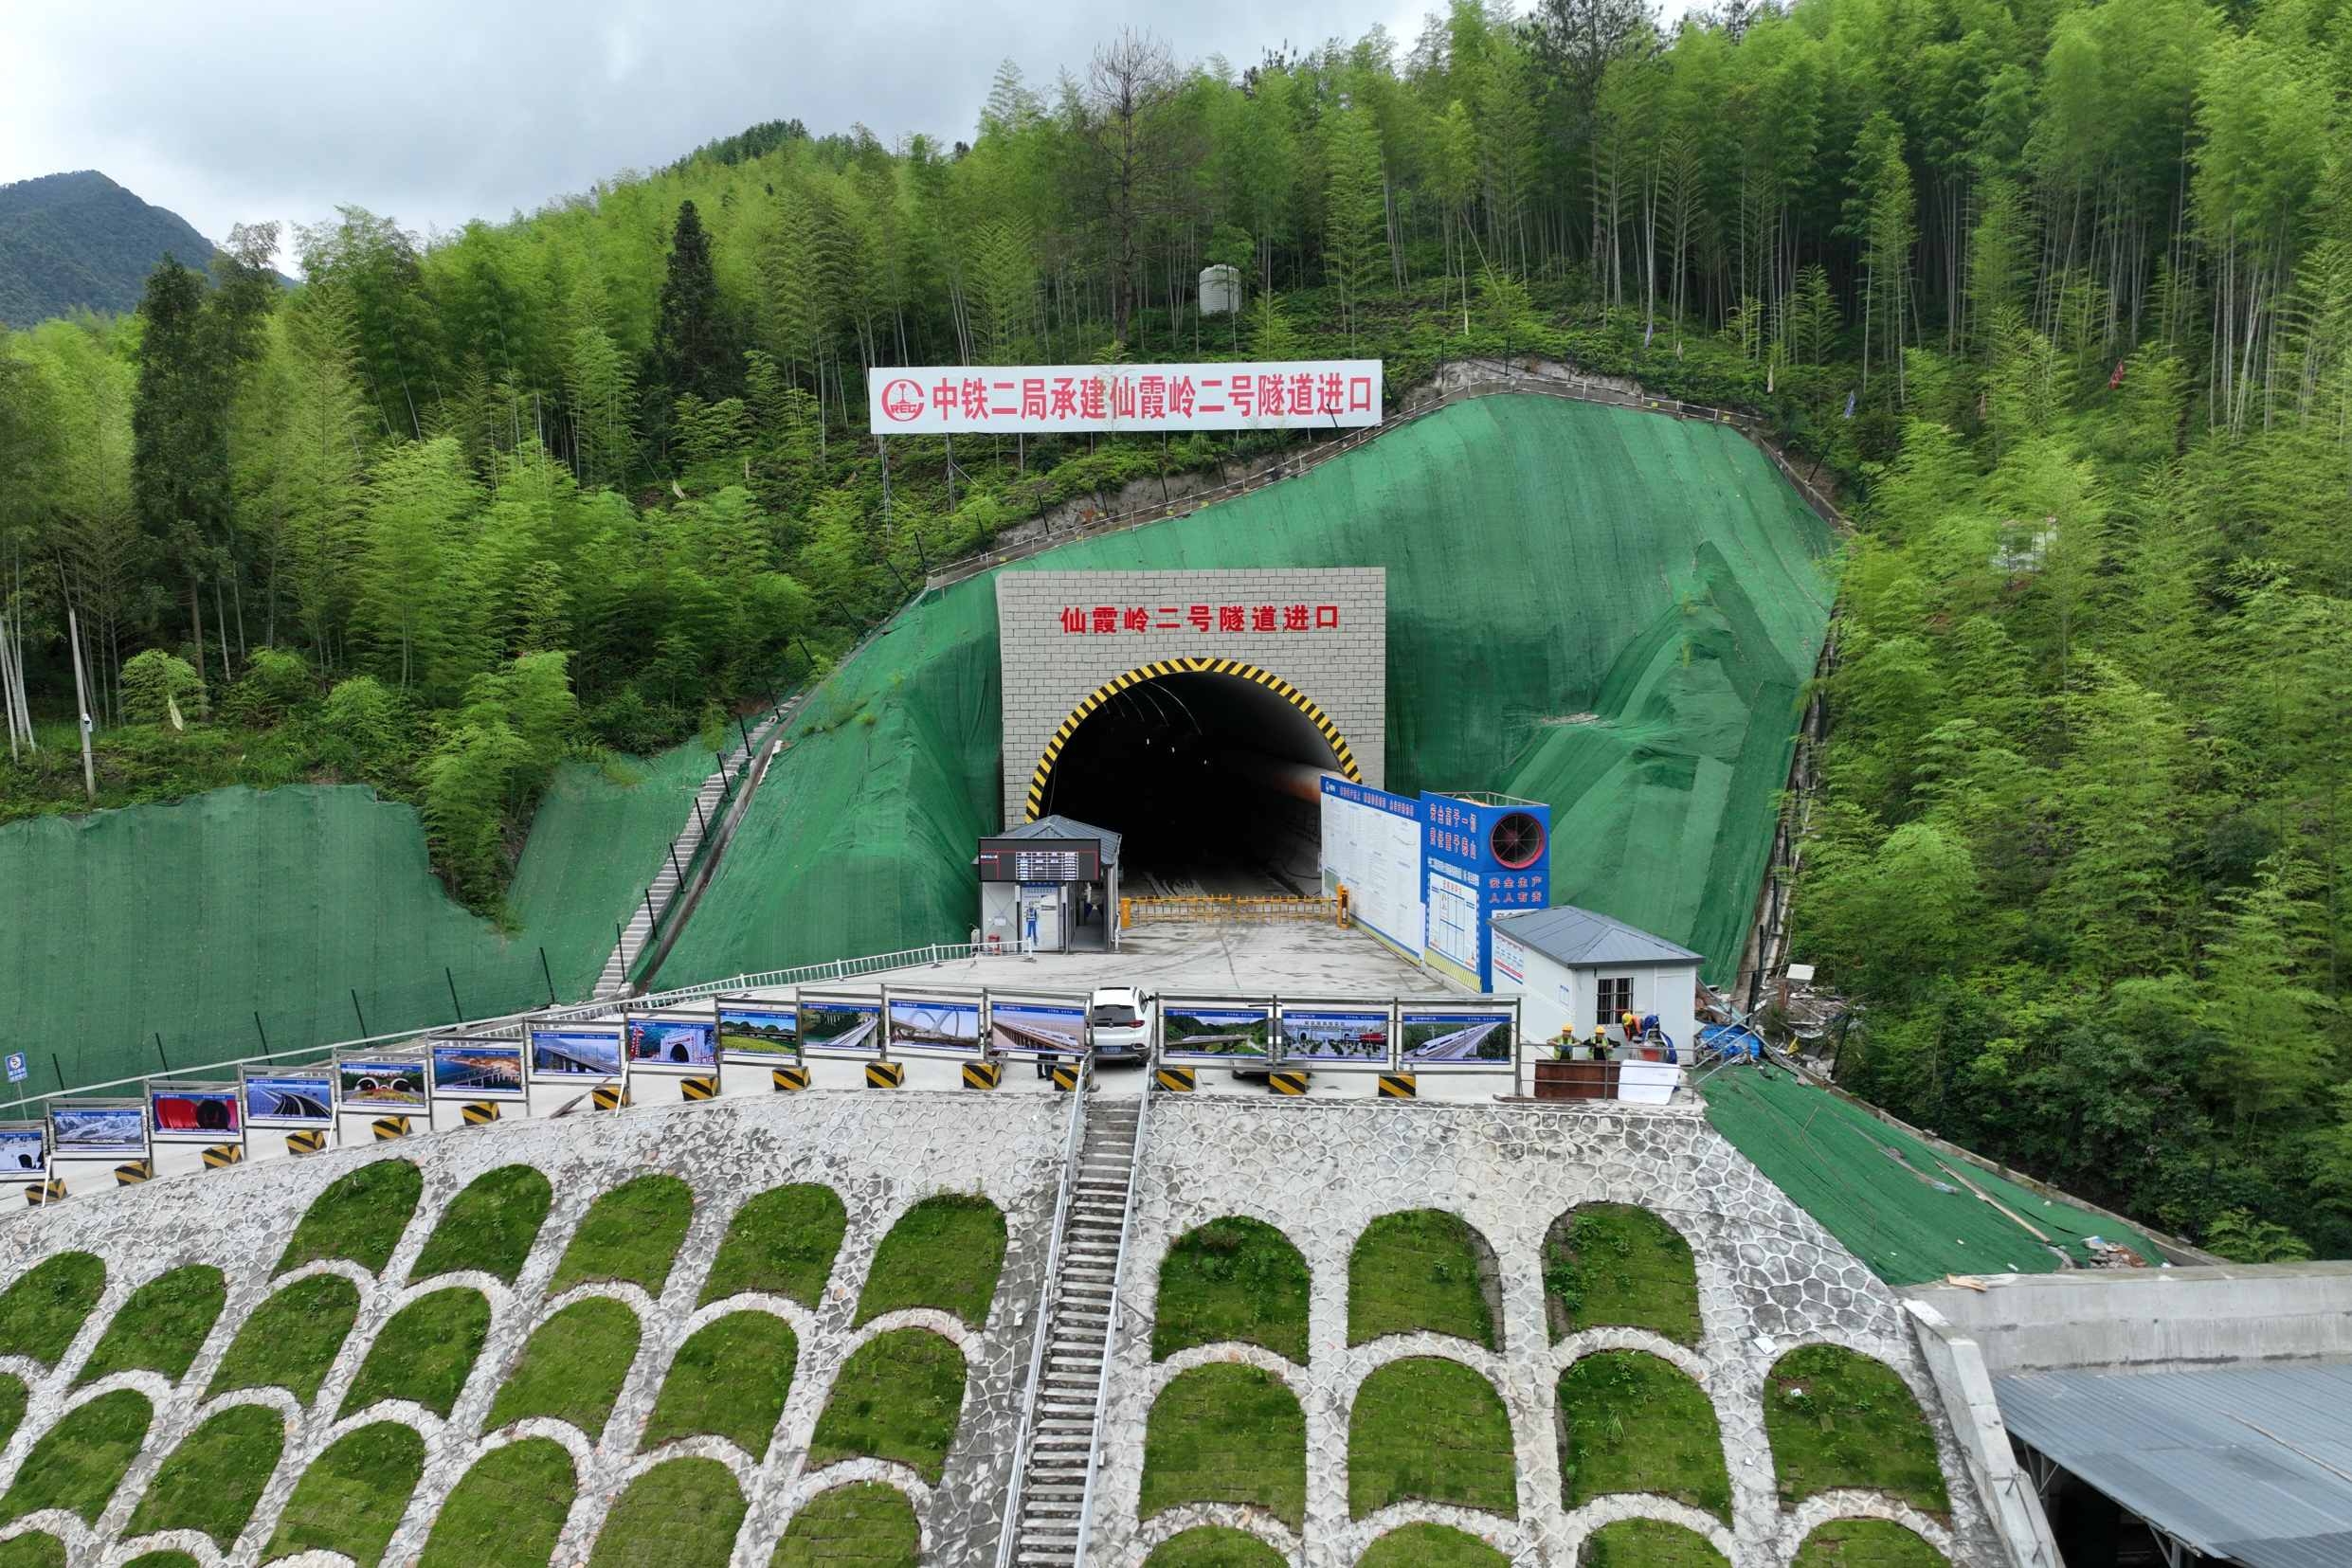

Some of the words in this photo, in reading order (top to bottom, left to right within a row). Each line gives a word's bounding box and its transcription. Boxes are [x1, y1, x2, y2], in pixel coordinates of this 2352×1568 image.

[932, 372, 1372, 421] 中铁二局承建仙霞岭二号隧道进口
[1060, 604, 1339, 634] 仙霞岭二号隧道进口
[1489, 875, 1542, 889] 安全生产
[1489, 892, 1542, 903] 人人有责
